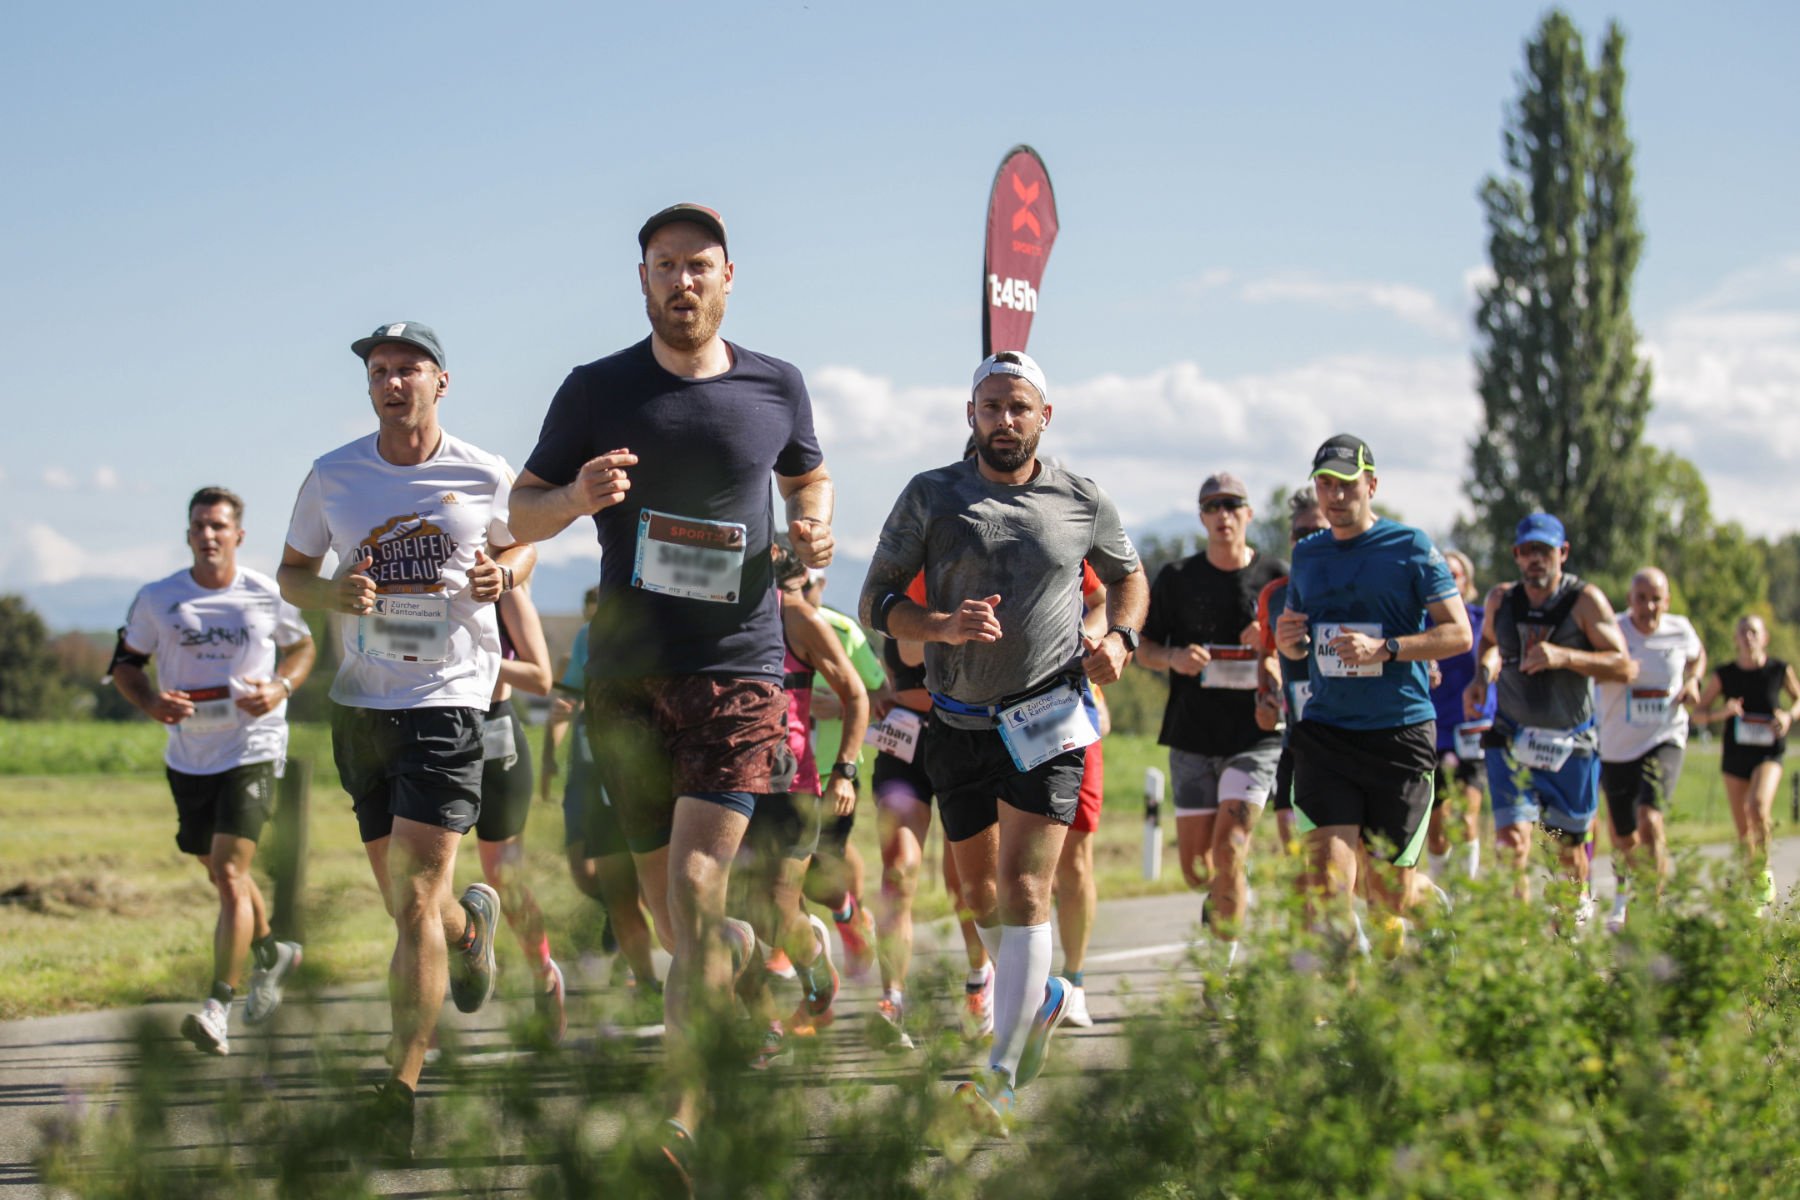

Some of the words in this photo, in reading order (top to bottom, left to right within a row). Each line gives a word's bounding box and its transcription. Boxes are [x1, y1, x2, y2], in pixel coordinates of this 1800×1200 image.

[988, 273, 1037, 312] 1:45h
[370, 558, 443, 582] SEELAUF
[390, 607, 441, 618] Kantonalbank
[391, 600, 420, 609] Zürcher
[1026, 695, 1053, 711] Zürcher
[1029, 696, 1073, 716] Kantonalbank
